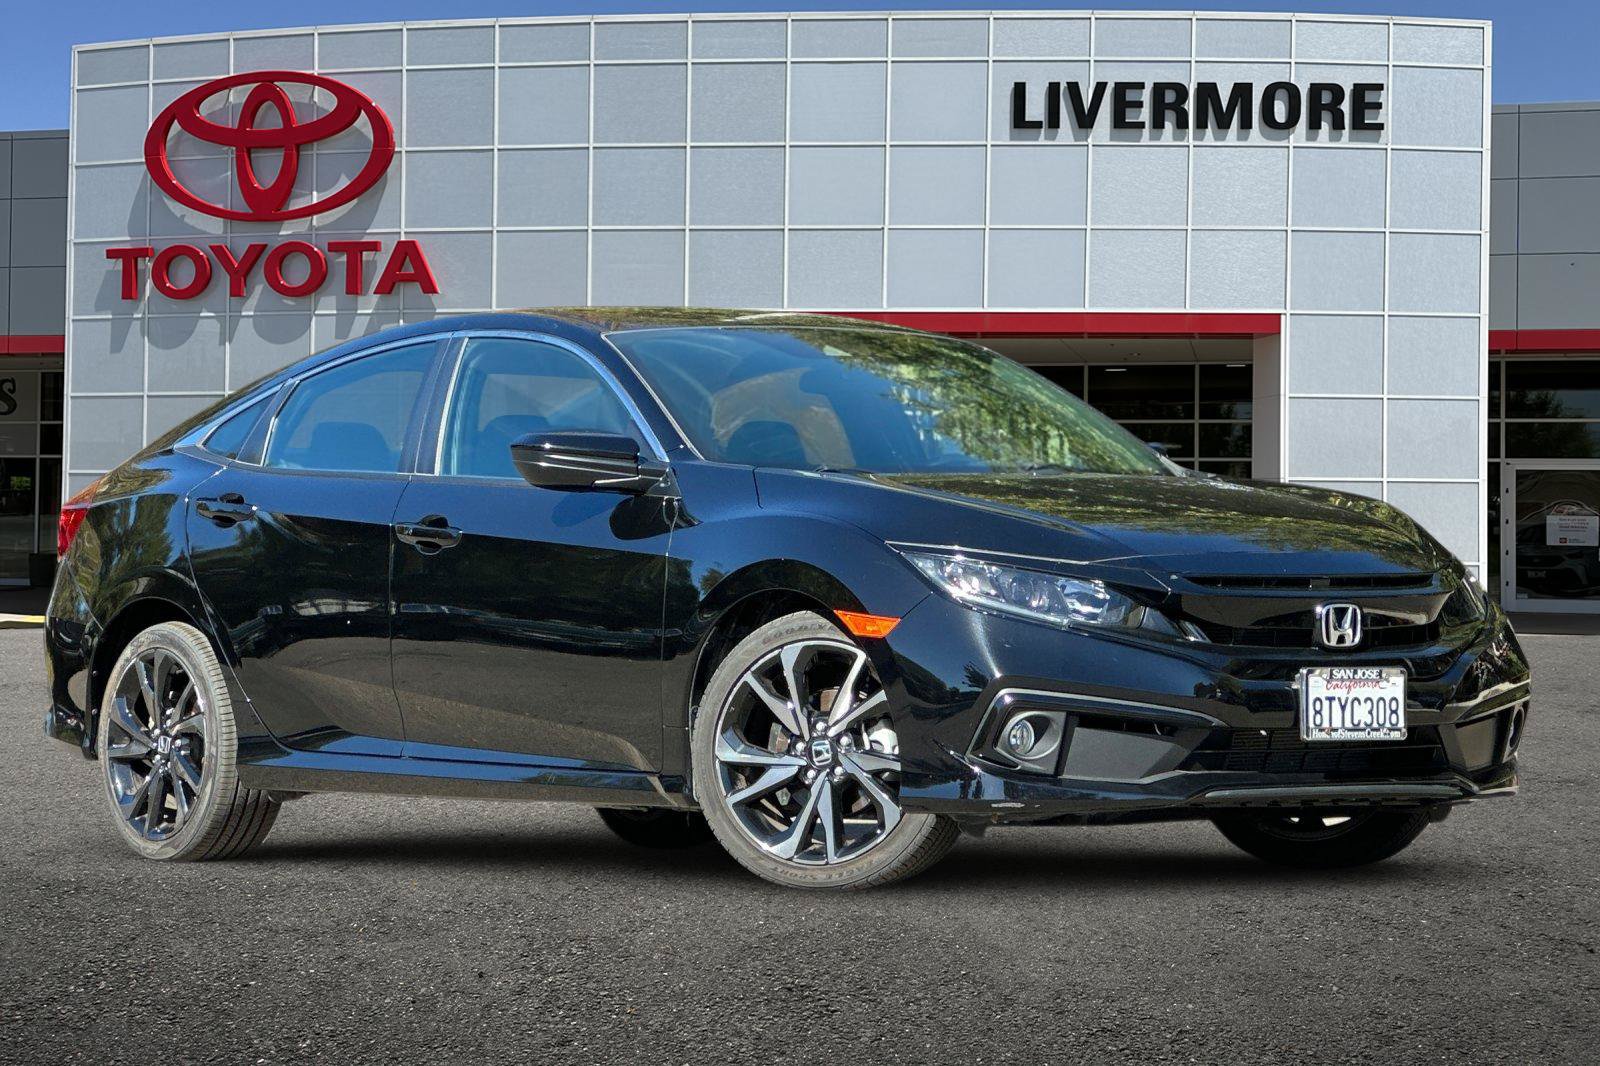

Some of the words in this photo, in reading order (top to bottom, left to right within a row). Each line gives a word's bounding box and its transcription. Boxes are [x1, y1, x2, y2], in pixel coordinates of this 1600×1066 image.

[1012, 81, 1384, 131] LIVERMORE
[106, 240, 440, 300] TOYOTA
[1325, 680, 1382, 695] California
[1332, 669, 1353, 680] SAN
[1354, 669, 1381, 680] JOSE
[1312, 696, 1400, 728] 8TYC308
